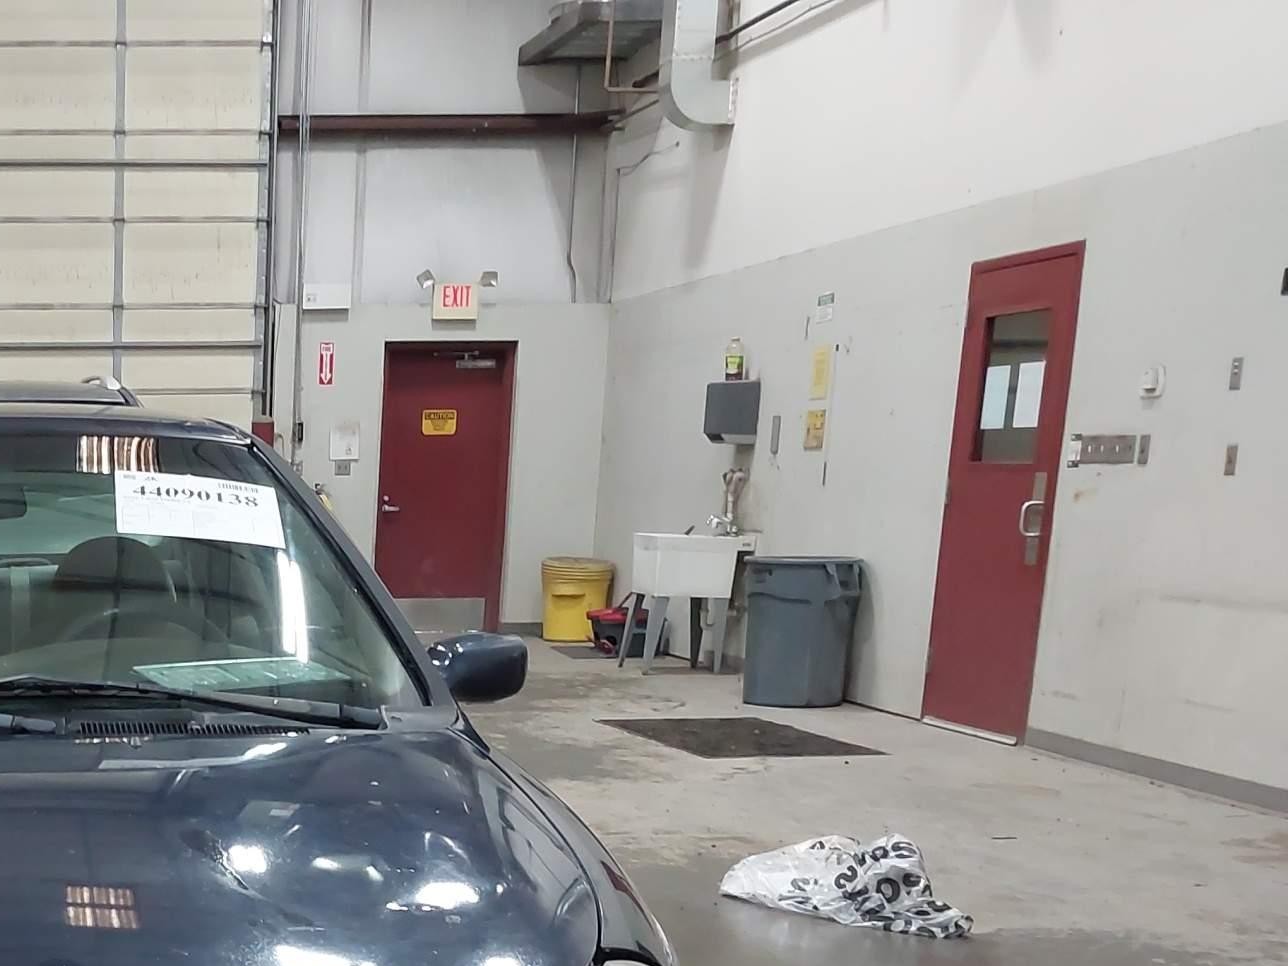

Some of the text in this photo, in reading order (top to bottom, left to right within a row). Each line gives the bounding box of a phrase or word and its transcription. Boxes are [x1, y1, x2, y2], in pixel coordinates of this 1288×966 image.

[443, 285, 472, 308] EXIT
[425, 411, 455, 420] CAUTION
[133, 485, 259, 508] 44090138
